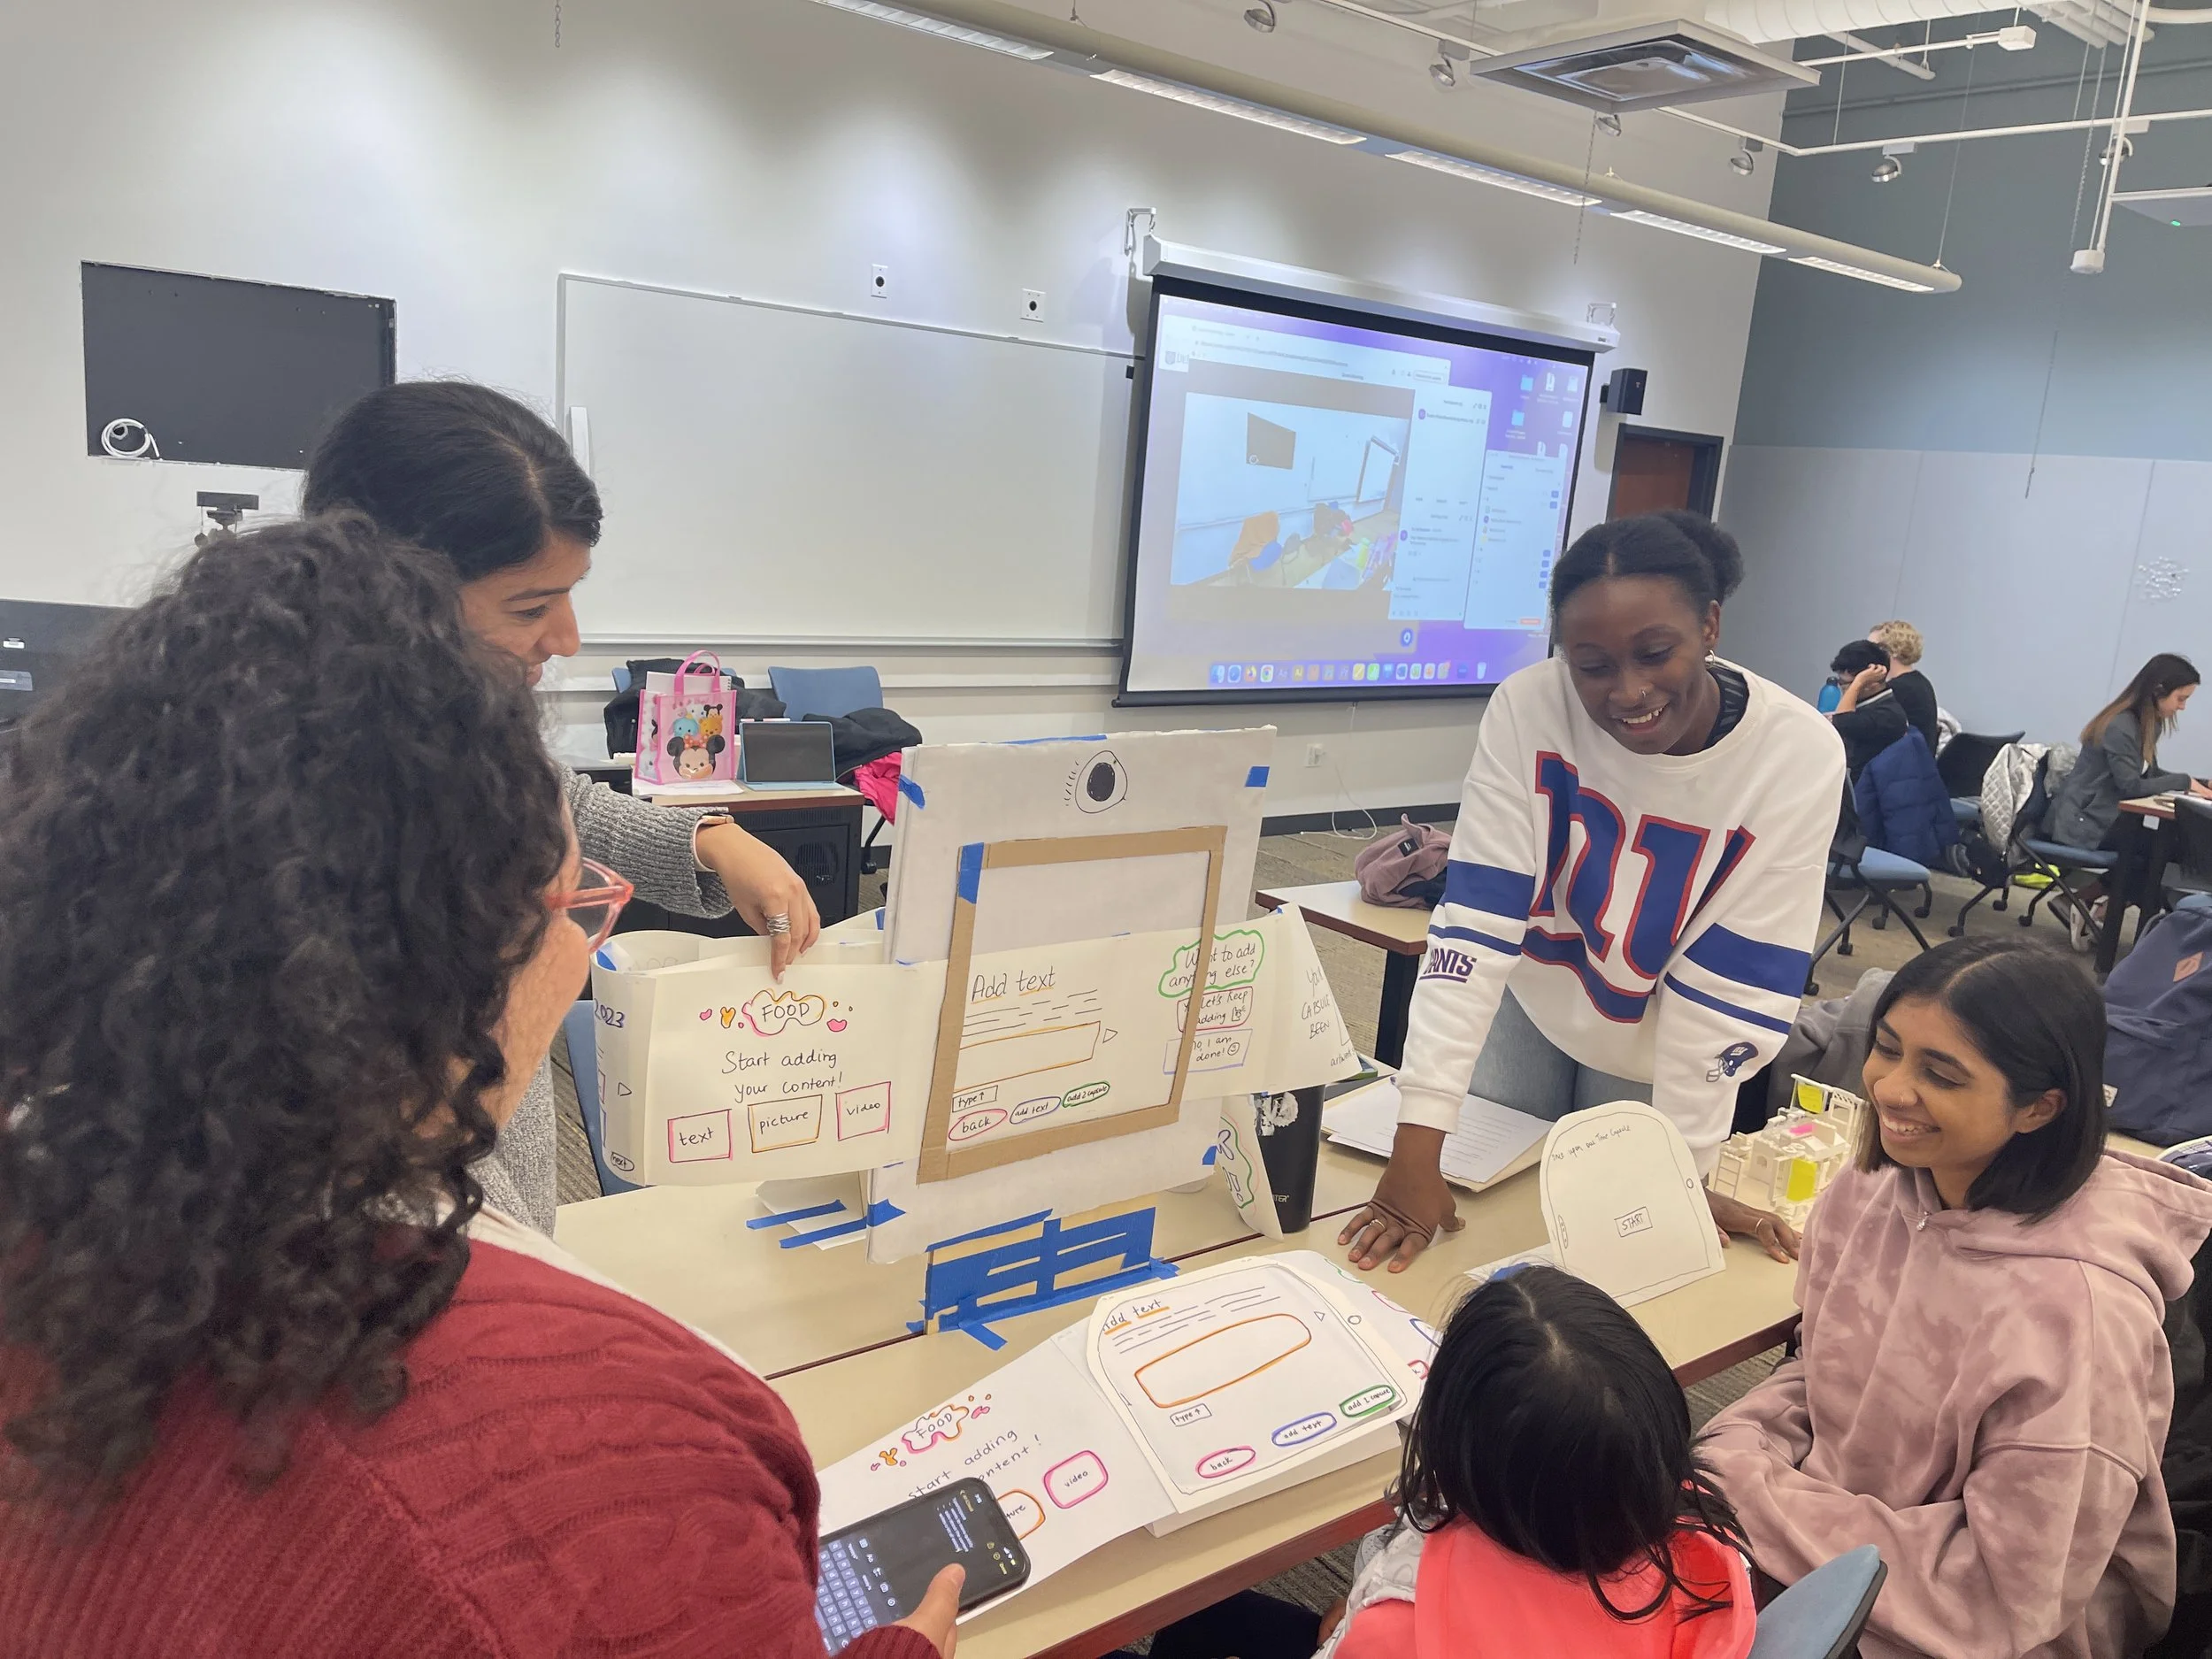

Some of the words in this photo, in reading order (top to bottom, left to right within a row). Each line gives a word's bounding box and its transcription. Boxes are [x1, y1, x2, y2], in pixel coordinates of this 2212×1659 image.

[1222, 945, 1233, 963] to
[1236, 943, 1256, 959] add
[1225, 959, 1255, 978] else?
[972, 973, 1007, 1002] Add
[1016, 965, 1056, 992] text
[593, 997, 626, 1028] 2023
[761, 1002, 810, 1023] FOOD
[721, 1050, 771, 1074] Start
[781, 1050, 838, 1069] adding
[1196, 1048, 1225, 1062] done!
[734, 1082, 769, 1103] your
[958, 1094, 978, 1108] type
[1066, 1091, 1082, 1102] add
[846, 1101, 881, 1117] video
[1014, 1107, 1029, 1117] add
[1032, 1102, 1049, 1115] text
[759, 1110, 810, 1134] picture
[962, 1116, 992, 1133] back
[679, 1127, 715, 1148] text
[1621, 1212, 1644, 1231] START
[1133, 1298, 1162, 1317] text
[1347, 1400, 1363, 1411] add
[916, 1412, 953, 1440] FOOD
[1173, 1409, 1194, 1425] type
[1282, 1425, 1299, 1440] add
[1302, 1418, 1323, 1432] text
[964, 1430, 1018, 1465] adding
[1210, 1455, 1233, 1472] back
[1064, 1470, 1089, 1488] video
[1005, 1504, 1026, 1520] ture
